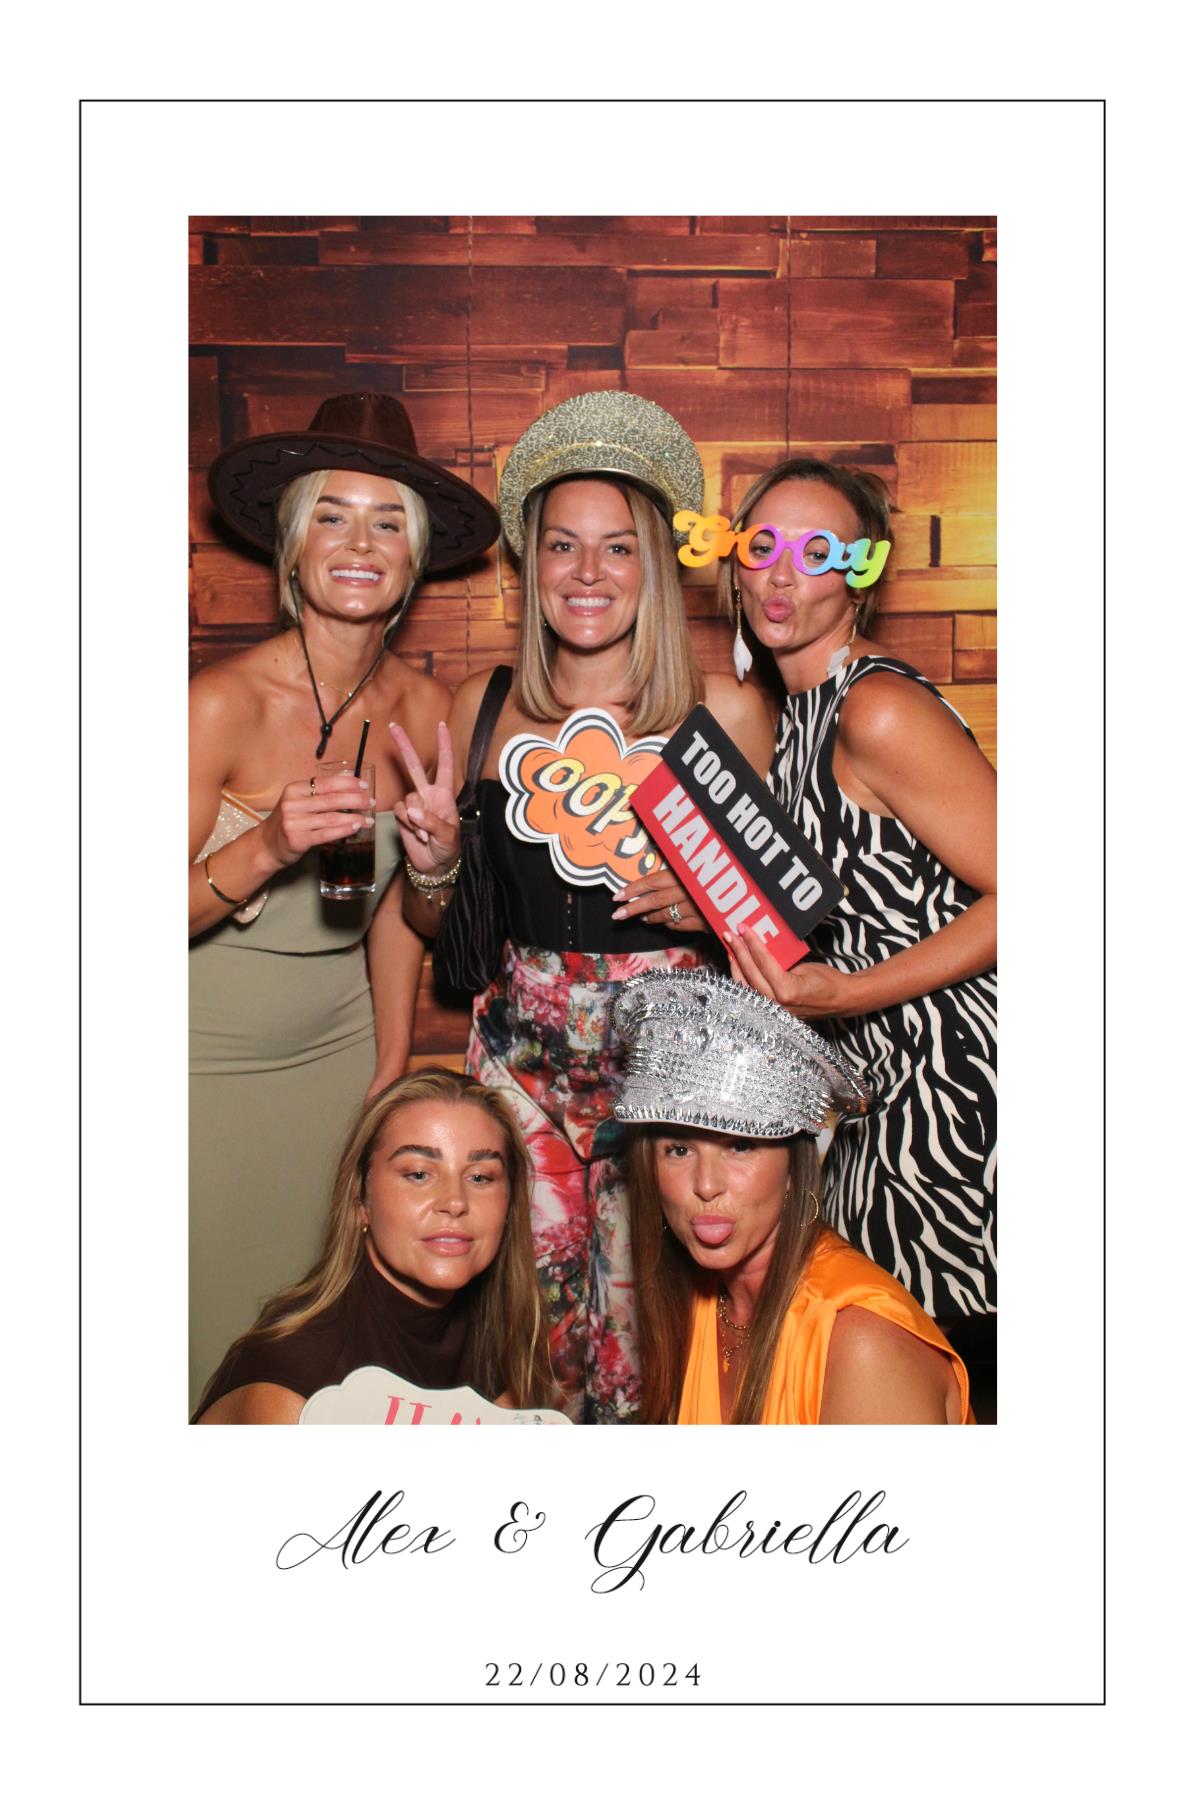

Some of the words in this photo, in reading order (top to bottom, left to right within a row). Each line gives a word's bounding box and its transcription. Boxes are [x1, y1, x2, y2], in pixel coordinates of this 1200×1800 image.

[681, 730, 737, 805] TOO
[726, 793, 790, 867] HOT
[778, 855, 823, 911] TO
